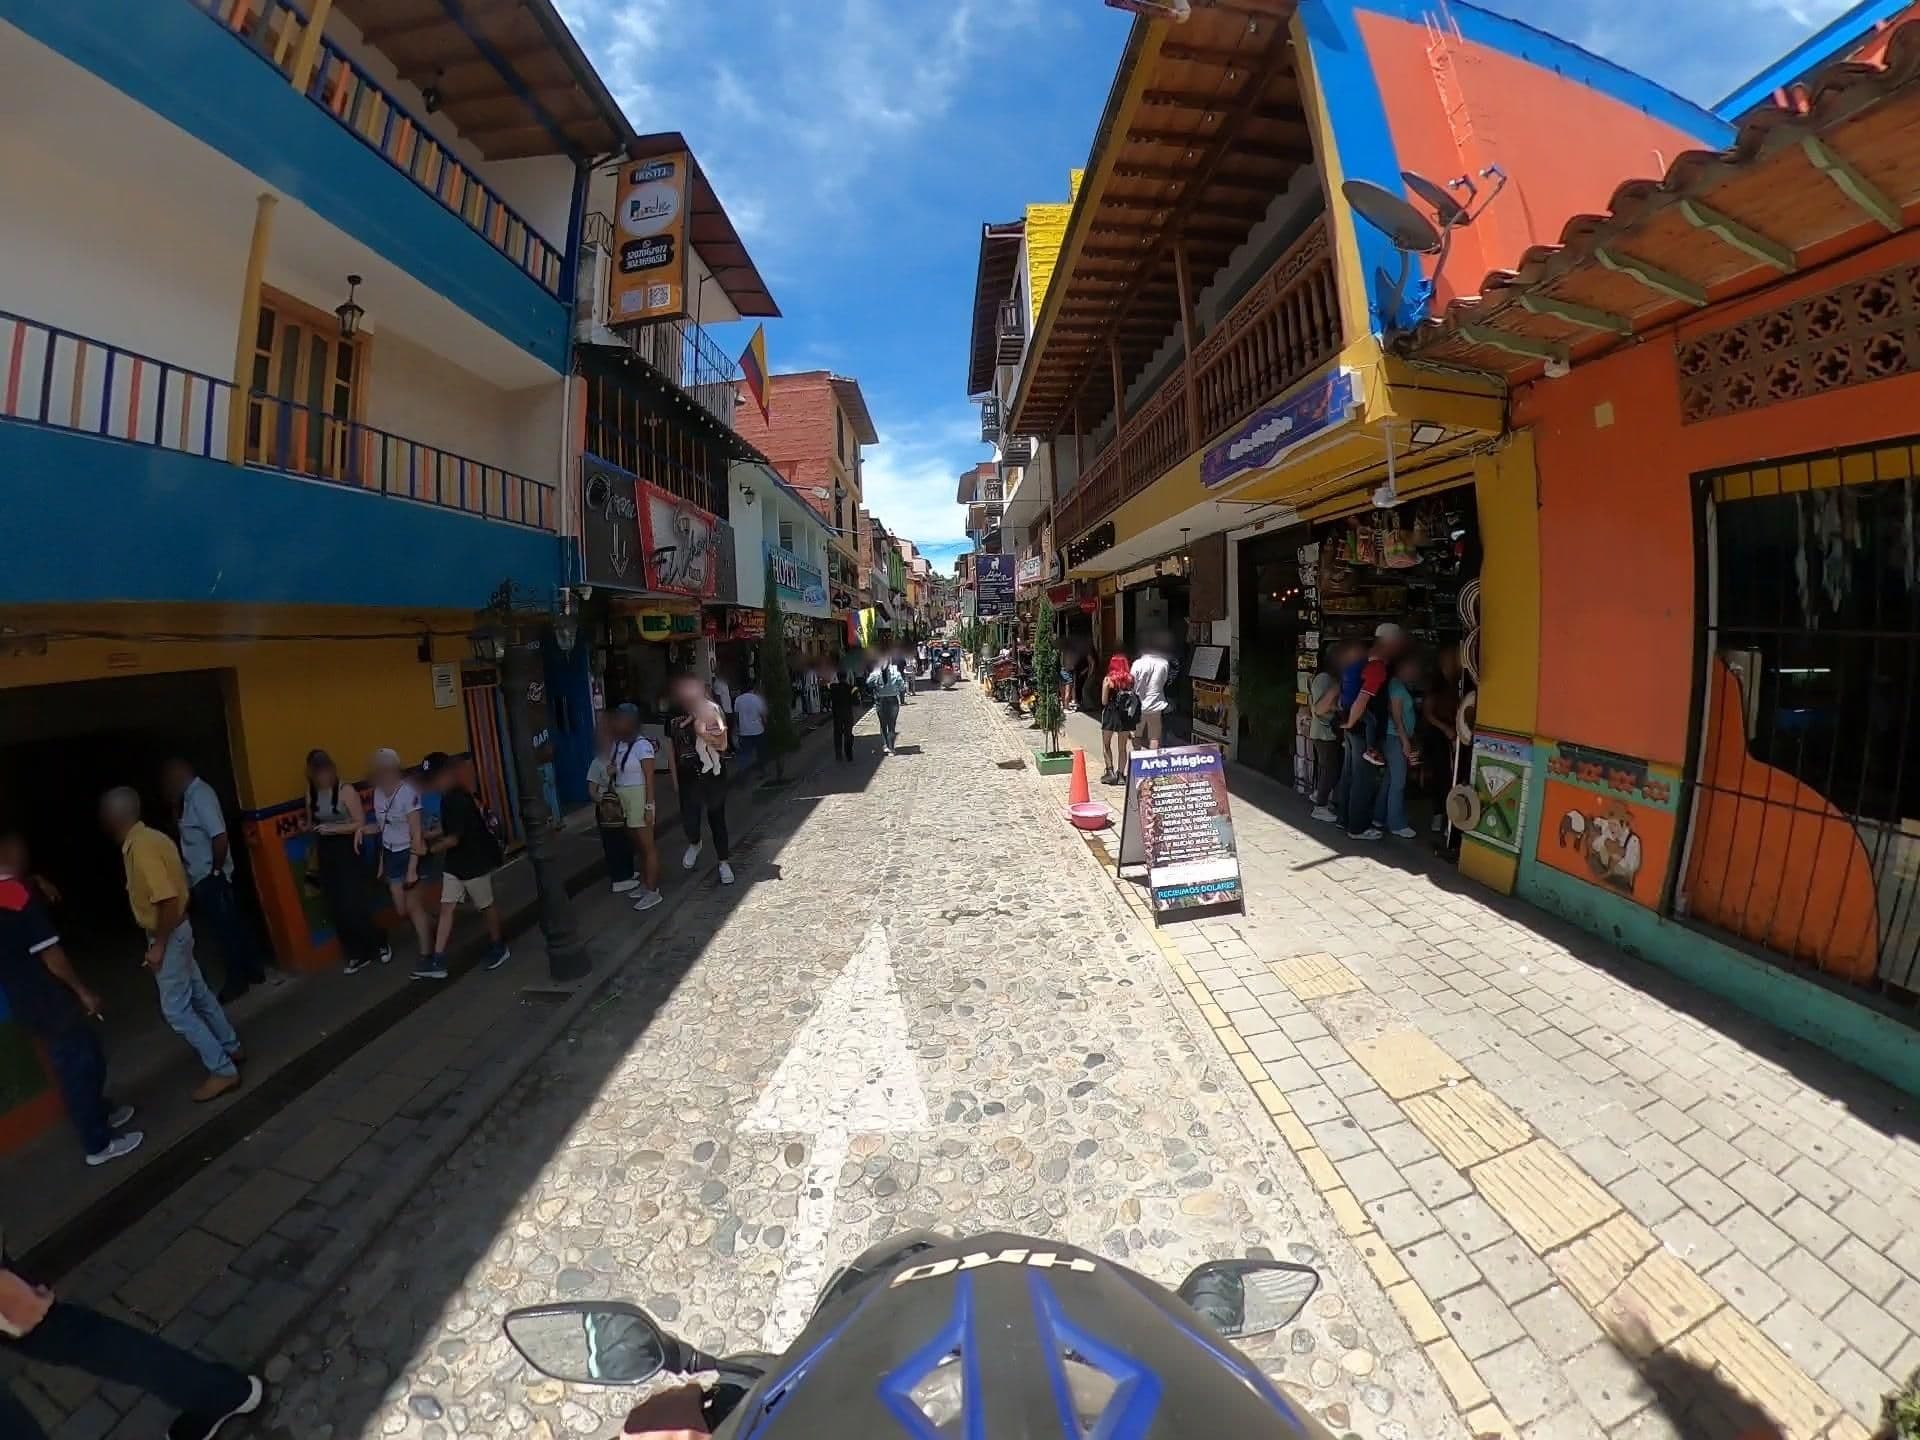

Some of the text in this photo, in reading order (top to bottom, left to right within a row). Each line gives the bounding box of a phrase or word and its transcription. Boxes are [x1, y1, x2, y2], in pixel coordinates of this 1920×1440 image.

[772, 555, 801, 589] HOTEL
[1141, 754, 1215, 770] Arte Mágico
[1157, 881, 1235, 898] RECIBIMOS DOLARES
